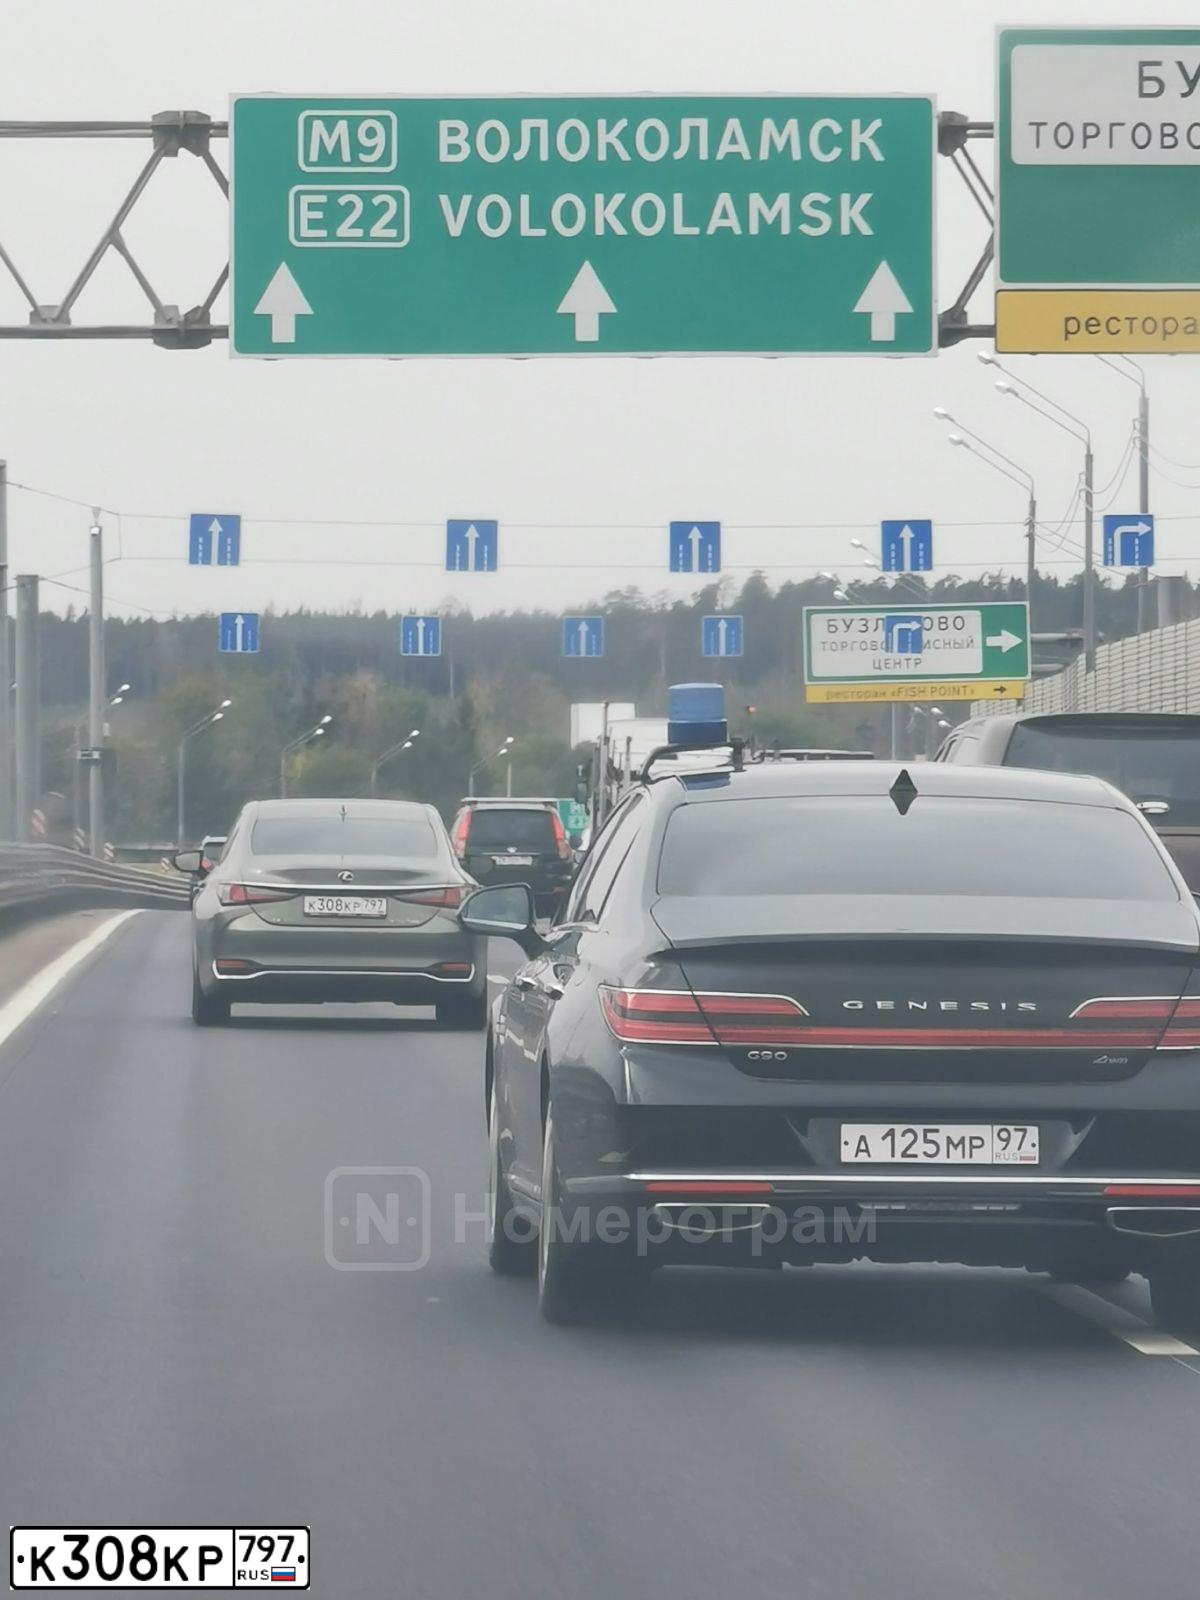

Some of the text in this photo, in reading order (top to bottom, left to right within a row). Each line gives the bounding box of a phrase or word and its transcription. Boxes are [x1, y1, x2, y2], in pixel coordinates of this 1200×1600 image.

[1138, 60, 1200, 98] БУ
[308, 118, 387, 163] М9
[438, 117, 886, 163] ВОЛОКОЛАМСК
[1028, 121, 1200, 150] ТОРГОВО
[299, 193, 398, 238] E22
[438, 192, 875, 237] VOLOKOLAMSK
[1063, 316, 1200, 341] рестора
[826, 615, 966, 634] БУЗЛОВО
[872, 657, 922, 671] ЦЕНТР
[308, 898, 361, 912] К308КР
[842, 1000, 1037, 1011] GENESIS
[747, 1050, 788, 1061] G90
[996, 1127, 1027, 1151] 97
[994, 1152, 1018, 1161] RUS
